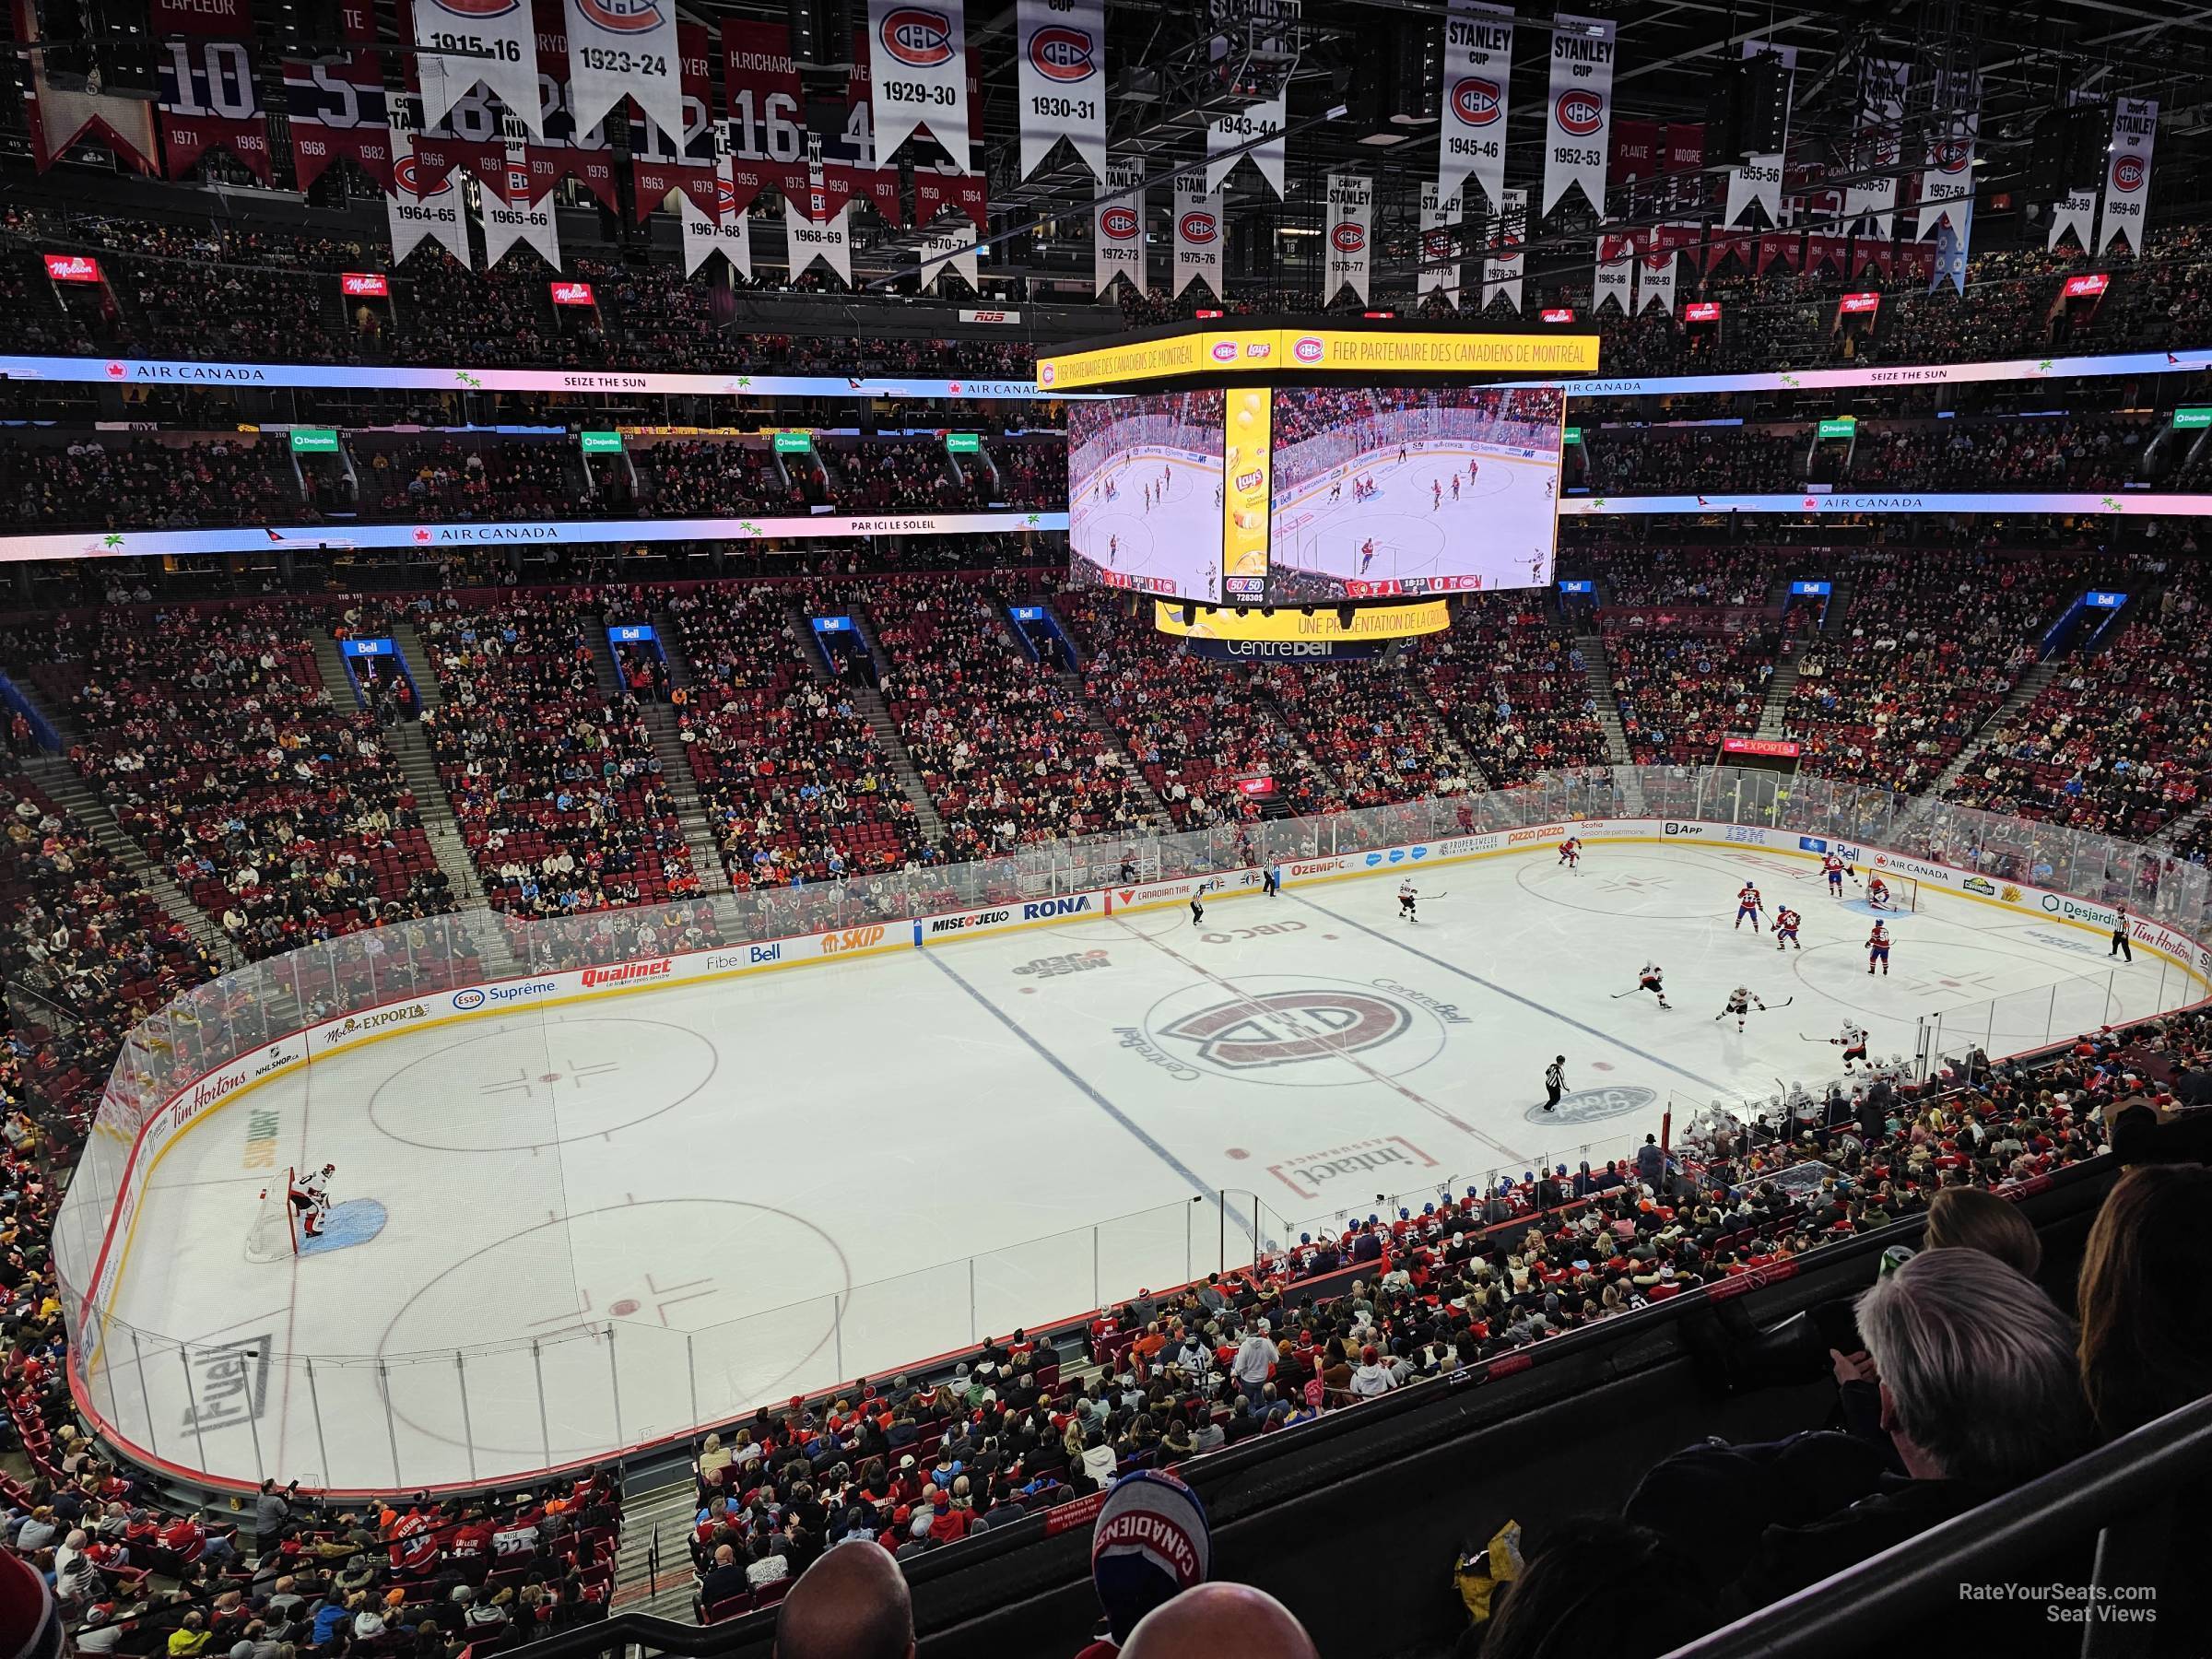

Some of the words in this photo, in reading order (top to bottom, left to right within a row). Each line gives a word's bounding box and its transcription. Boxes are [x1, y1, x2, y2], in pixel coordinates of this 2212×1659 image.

[1449, 21, 1511, 51] STANLEY
[430, 32, 521, 63] 1915-16
[1555, 36, 1613, 64] STANLEY
[580, 47, 667, 76] 1923-24
[729, 50, 796, 75] H.RICHARD
[1469, 52, 1489, 65] CUP
[1573, 65, 1593, 77] CUP
[163, 42, 257, 120] 10
[883, 81, 956, 105] 1929-30
[1031, 97, 1095, 120] 1930-31
[2127, 104, 2148, 114] COUPE
[735, 89, 801, 163] 16
[1218, 118, 1277, 135] 1943-44
[2116, 116, 2155, 135] STANLEY
[171, 130, 198, 146] 1971
[235, 135, 264, 151] 1985
[2127, 137, 2140, 147] CUP
[300, 141, 326, 157] 1968
[359, 146, 385, 161] 1982
[1449, 137, 1499, 158] 1945-46
[1620, 144, 1650, 159] PLANTE
[419, 152, 444, 168] 1966
[1554, 147, 1601, 167] 1952-53
[1674, 148, 1702, 163] MOORE
[478, 157, 502, 172] 1981
[532, 160, 553, 175] 1970
[586, 165, 608, 179] 1979
[737, 172, 759, 186] 1955
[1739, 165, 1780, 182] 1955-56
[641, 176, 665, 191] 1963
[692, 180, 714, 194] 1979
[785, 176, 805, 190] 1975
[829, 181, 849, 193] 1950
[876, 184, 894, 197] 1971
[1338, 180, 1361, 190] COUPE
[921, 187, 940, 200] 1950
[962, 190, 982, 203] 1964
[1192, 195, 1207, 204] CUP
[1328, 188, 1371, 206] STANLEY
[396, 205, 456, 223] 1964-65
[1342, 206, 1357, 216] CUP
[2109, 202, 2140, 216] 1959-60
[489, 209, 548, 227] 1965-66
[689, 223, 741, 238] 1967-68
[794, 229, 842, 244] 1968-69
[1101, 248, 1139, 260] 1972-73
[1180, 252, 1216, 265] 1975-76
[51, 261, 93, 276] Molson
[1331, 262, 1364, 273] 1976-77
[347, 278, 383, 291] Molson
[1643, 275, 1671, 286] 1992-93
[556, 288, 588, 302] Molson
[1334, 341, 1357, 360] FIER
[1360, 342, 1429, 361] PARTENAIRE
[1430, 343, 1452, 361] DES
[1455, 344, 1513, 363] CANADIENS
[1516, 344, 1530, 363] DE
[1532, 341, 1585, 364] MONTRÉAL
[1114, 351, 1147, 371] CANADIENS
[137, 366, 172, 378] AIR
[179, 367, 265, 380] CANADA
[1871, 371, 1899, 382] SEIZE
[1901, 371, 1922, 380] THE
[1925, 370, 1947, 379] SUN
[564, 377, 594, 387] SEIZE
[598, 378, 619, 387] THE
[622, 378, 647, 388] SUN
[968, 384, 991, 394] AIR
[1559, 382, 1582, 393] AIR
[1585, 381, 1642, 392] CANADA
[1824, 498, 1851, 508] AIR
[1855, 499, 1923, 508] CANADA
[852, 521, 872, 531] PAR
[875, 521, 888, 531] ICI
[890, 521, 901, 531] LE
[903, 520, 935, 530] SOLEIL
[441, 529, 473, 541] AIR
[478, 528, 559, 540] CANADA
[1229, 580, 1262, 591] 50/50
[1434, 578, 1442, 590] 0
[1568, 582, 1582, 591] Bell
[1804, 584, 1819, 593] Bell
[2098, 595, 2114, 605] Bell
[1019, 609, 1033, 618] Bell
[824, 618, 839, 628] Bell
[1298, 617, 1322, 634] UNE
[1405, 611, 1417, 628] DE
[622, 629, 639, 639] Bell
[358, 641, 377, 653] Bell
[1227, 640, 1333, 655] CentreBell
[1581, 821, 1604, 830] Scotia
[1679, 825, 1703, 834] App
[1508, 832, 1535, 845] pizza
[1536, 826, 1565, 841] pizza
[1725, 825, 1766, 844] IBM
[1838, 844, 1860, 863] Bell
[1290, 857, 1345, 877] OZEMPIC
[1888, 859, 1905, 870] AIR
[1907, 864, 1949, 881] CANADA
[1138, 888, 1173, 900] CANADIAN
[1175, 884, 1191, 896] TIRE
[1024, 895, 1092, 921] RONA
[840, 925, 885, 950] SKIP
[2132, 921, 2155, 945] Tim
[707, 954, 738, 970] Fibe
[750, 943, 781, 963] Bell
[582, 959, 673, 988] Qualinet
[489, 982, 556, 1001] Suprême
[457, 994, 481, 1005] Esso
[324, 1023, 362, 1043] Molson
[363, 1006, 416, 1030] EXPORT
[255, 1053, 300, 1077] NHLSHOP.CA
[171, 1099, 192, 1129] Tim
[194, 1071, 246, 1112] Hortons
[1293, 1147, 1413, 1186] intact
[1191, 1357, 1205, 1371] 31
[1096, 1516, 1194, 1577] CANADIENS
